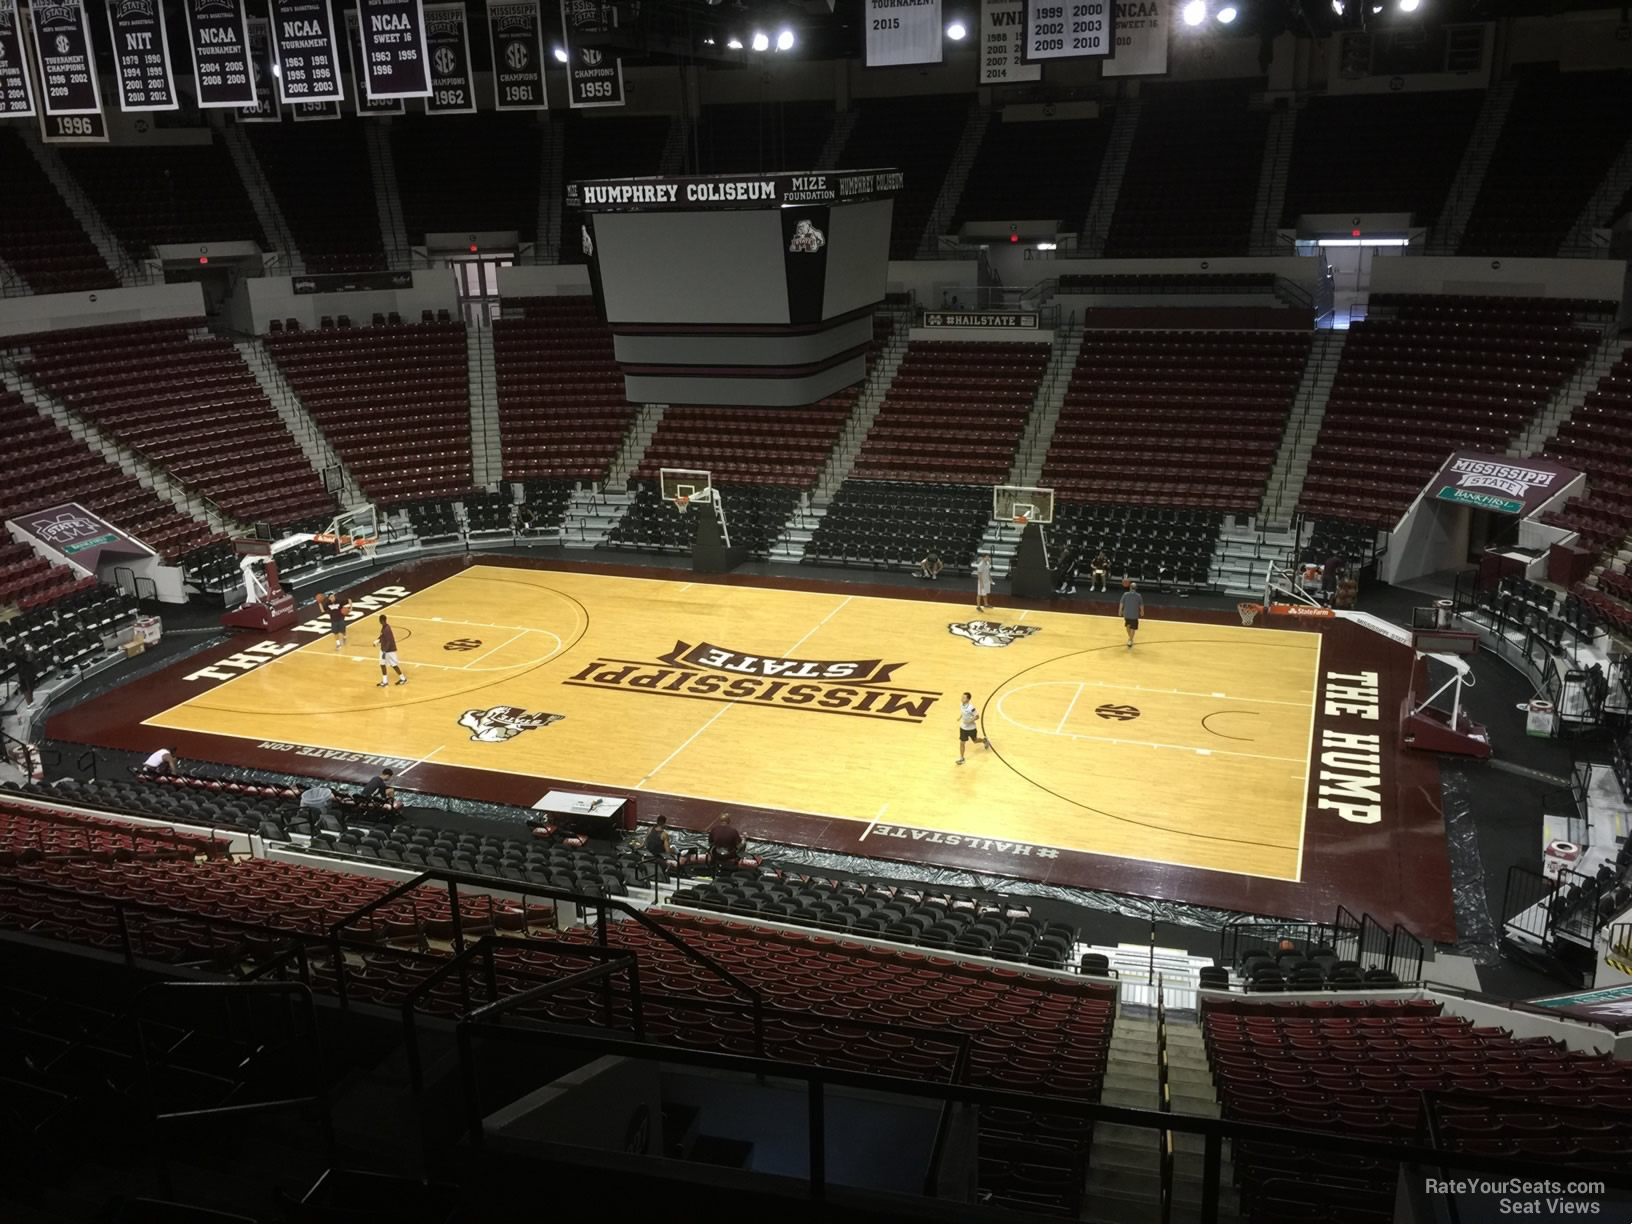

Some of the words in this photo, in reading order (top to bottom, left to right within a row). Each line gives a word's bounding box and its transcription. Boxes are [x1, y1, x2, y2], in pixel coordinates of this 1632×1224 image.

[122, 1, 147, 11] STATE
[490, 4, 537, 16] MISSISSIPPI
[1036, 7, 1063, 19] 1999
[1073, 4, 1102, 17] 2000
[1115, 3, 1159, 18] NCAA
[45, 6, 69, 19] STATE
[425, 11, 463, 22] SSISSIPPI
[371, 13, 411, 31] NCAA
[430, 23, 453, 33] STATE
[502, 17, 526, 27] STATE
[873, 18, 900, 30] 2015
[1035, 23, 1064, 36] 2002
[1073, 20, 1102, 33] 2003
[1115, 20, 1146, 29] SWEET
[283, 19, 322, 38] NCAA
[125, 32, 152, 50] NIT
[200, 27, 236, 44] NCAA
[373, 33, 400, 44] SWEET
[403, 33, 412, 42] 16
[987, 33, 1007, 42] 1988
[1117, 37, 1131, 45] 010
[281, 38, 328, 49] TOURNAMENT
[987, 45, 1007, 54] 2001
[1035, 39, 1063, 51] 2009
[1073, 36, 1100, 49] 2010
[197, 45, 242, 55] TOURNAMENT
[371, 51, 391, 62] 1963
[398, 50, 417, 61] 1995
[505, 41, 529, 70] SEC
[45, 55, 84, 65] TOURNAMENT
[122, 55, 139, 65] 1979
[285, 57, 304, 68] 1963
[311, 55, 328, 65] 1991
[433, 46, 457, 75] SEC
[987, 57, 1008, 66] 2007
[47, 63, 86, 73] CHAMPIONS
[123, 67, 141, 77] 1994
[200, 63, 220, 73] 2004
[225, 62, 244, 71] 2005
[373, 65, 393, 75] 1996
[575, 68, 614, 78] CHAMPIONS
[987, 69, 1007, 78] 2014
[49, 75, 66, 84] 1996
[70, 74, 88, 83] 2002
[202, 76, 222, 85] 2008
[227, 75, 246, 84] 2009
[287, 70, 306, 80] 1995
[312, 68, 331, 79] 1996
[500, 73, 538, 82] CHAMPIONS
[126, 79, 143, 89] 2001
[148, 79, 165, 88] 2007
[288, 82, 309, 93] 2002
[313, 81, 333, 92] 2003
[580, 81, 613, 98] 1959
[8, 89, 25, 98] 2004
[50, 87, 69, 96] 2009
[128, 92, 145, 101] 2010
[150, 91, 167, 100] 2012
[434, 90, 464, 105] 1962
[505, 86, 534, 101] 1961
[57, 117, 92, 134] 1996
[792, 176, 826, 191] MIZE
[839, 175, 874, 196] HUMPHREY
[876, 172, 904, 191] COLISEUM
[584, 185, 678, 204] HUMPHREY
[687, 181, 776, 201] COLISEUM
[784, 190, 835, 201] FOUNDATION
[946, 315, 1016, 326] #HAILSTATE
[1452, 460, 1555, 485] MISSISSIPPI
[1470, 477, 1515, 491] STATE
[48, 521, 85, 536] STATE
[182, 640, 299, 682] THE
[697, 648, 860, 679] STATE
[572, 662, 939, 718] MISSISSIPPI
[1324, 671, 1379, 721] THE
[257, 741, 414, 769] HAILSTATE.COM
[1318, 729, 1382, 825] HUMP
[873, 824, 1060, 860] #HAILSTATE
